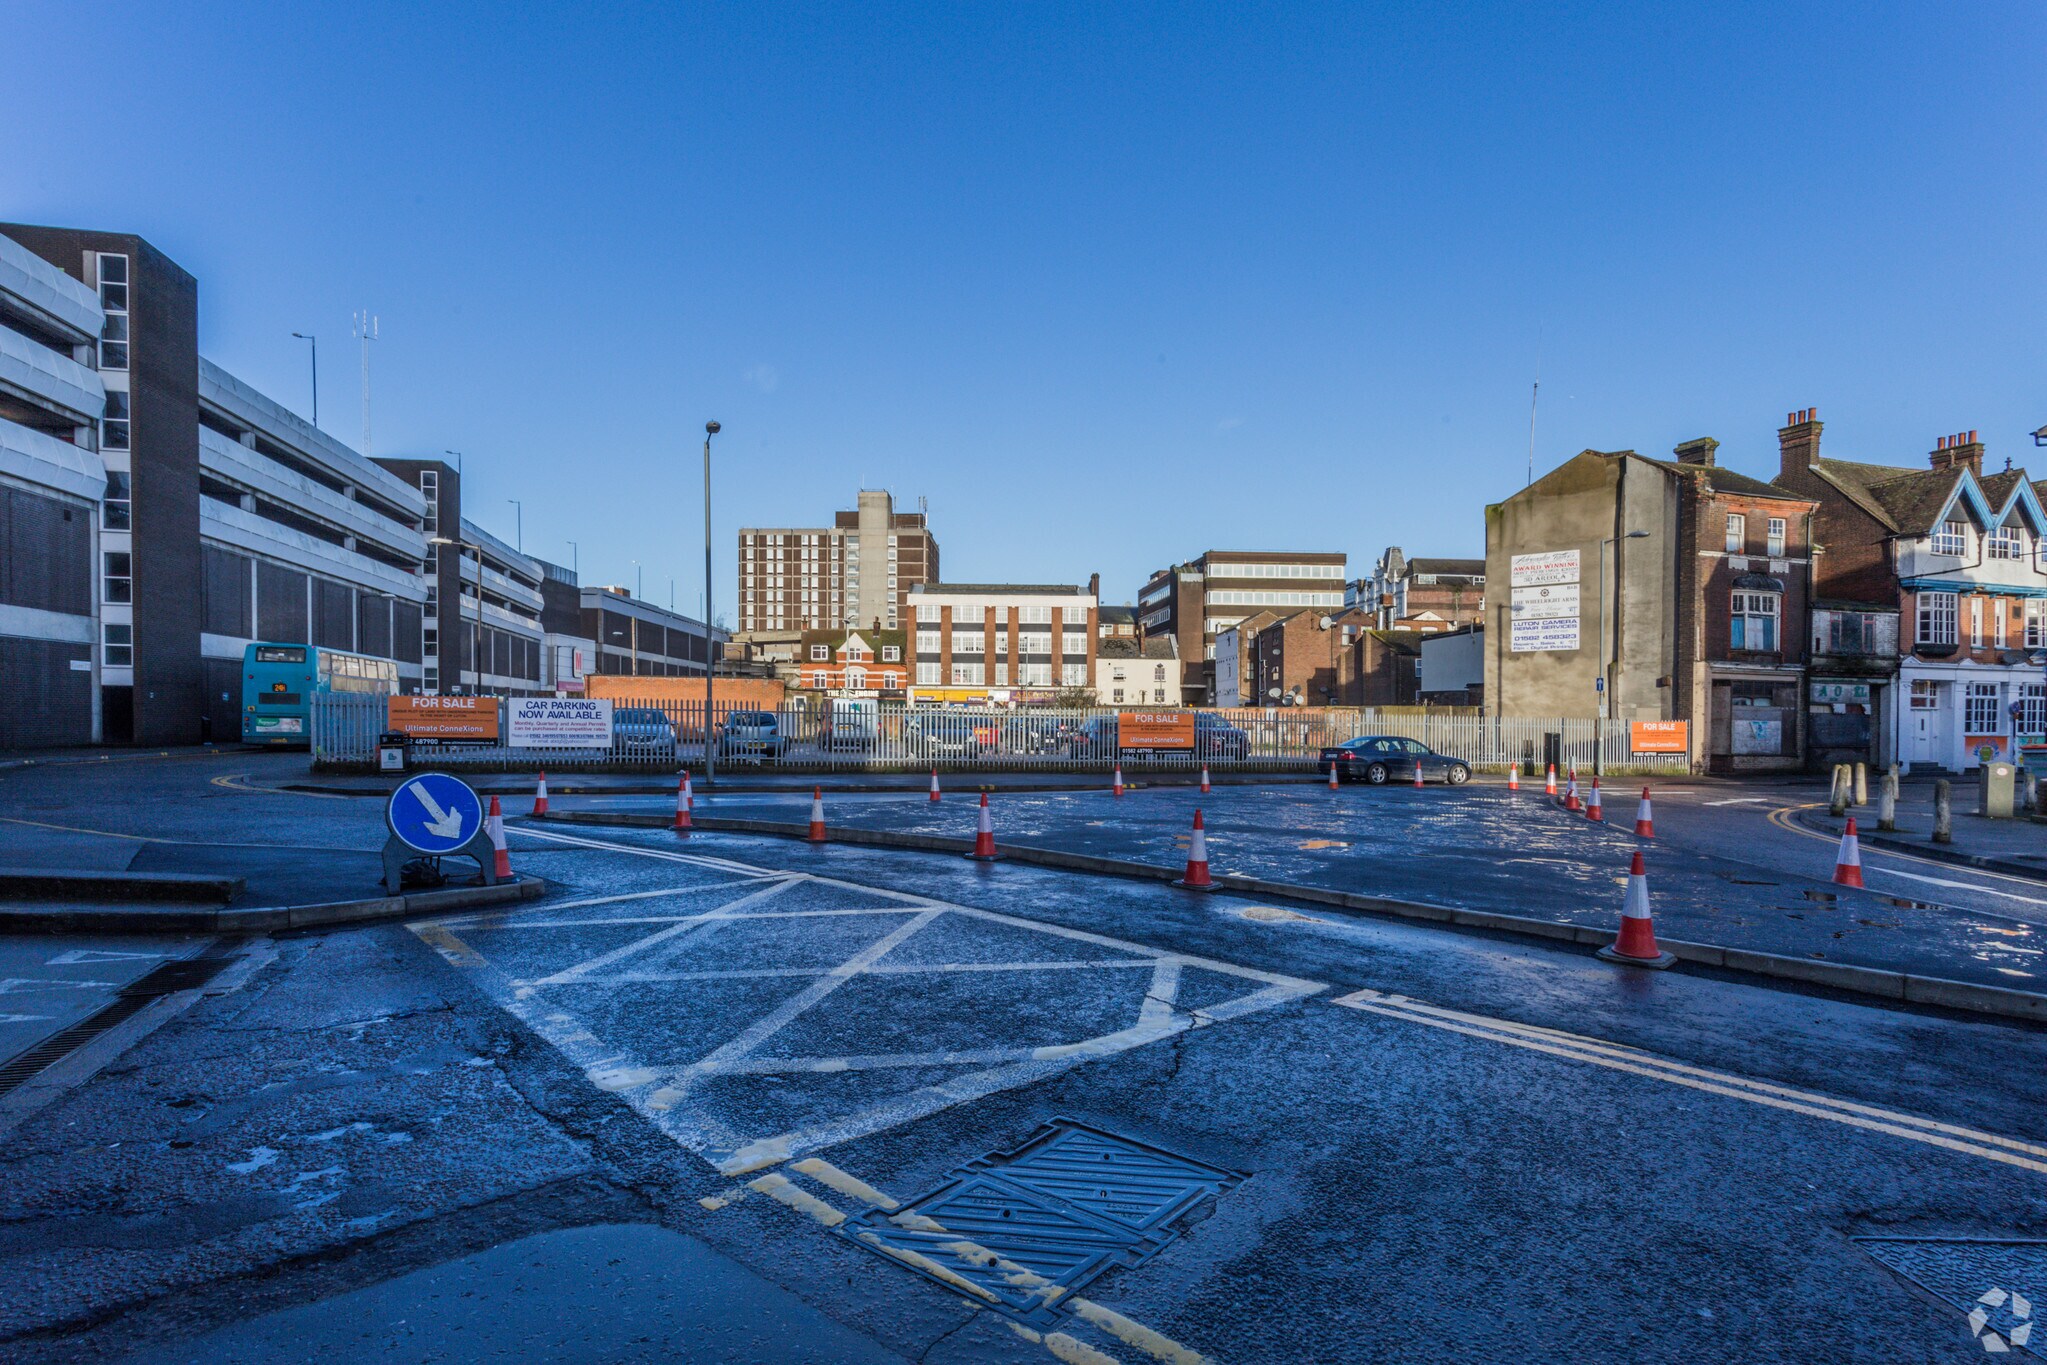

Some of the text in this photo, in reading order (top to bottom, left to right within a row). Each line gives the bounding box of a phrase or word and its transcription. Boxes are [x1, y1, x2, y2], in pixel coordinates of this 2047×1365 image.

[412, 698, 475, 708] FOR SALE
[526, 701, 596, 710] CAR PARKING
[547, 711, 602, 719] AVAILABLE
[1156, 715, 1178, 723] SALE
